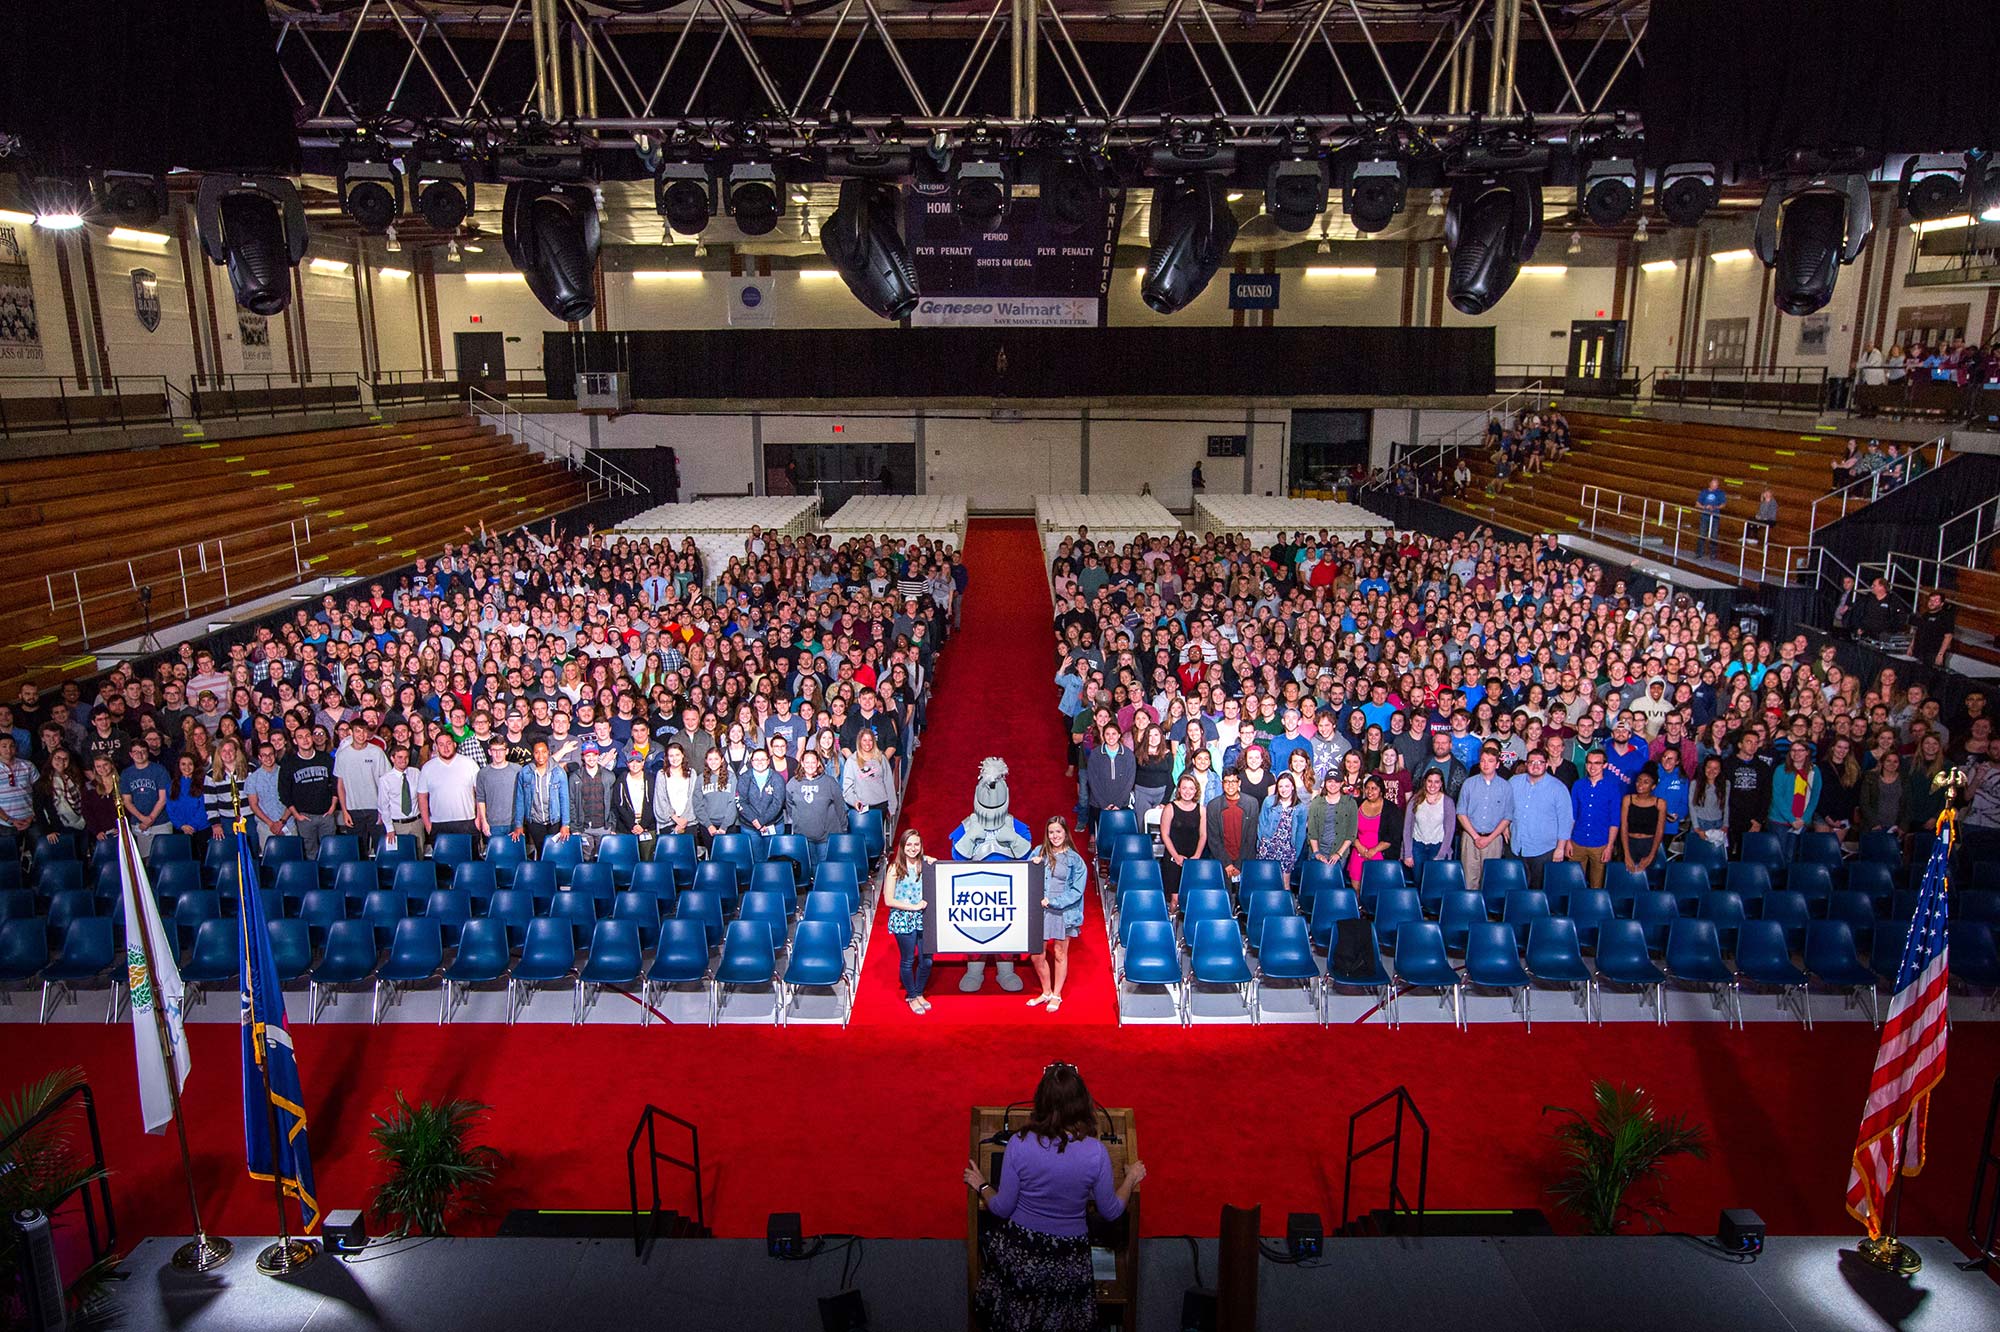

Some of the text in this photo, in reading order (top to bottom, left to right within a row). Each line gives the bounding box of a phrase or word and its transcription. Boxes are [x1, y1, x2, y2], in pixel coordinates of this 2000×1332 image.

[926, 202, 951, 214] HOM
[982, 233, 1009, 241] PERIOD
[916, 247, 973, 255] PLYR PENALTY
[1037, 247, 1095, 256] PLYR PENALTY
[1100, 202, 1117, 293] KNIGHTS
[976, 259, 1033, 267] SHOTS ON GOAL
[1236, 284, 1273, 298] GENESEO
[919, 301, 1062, 316] Geneseo Walmart
[956, 891, 1008, 906] #ONE
[948, 907, 1017, 922] KNIGHT
